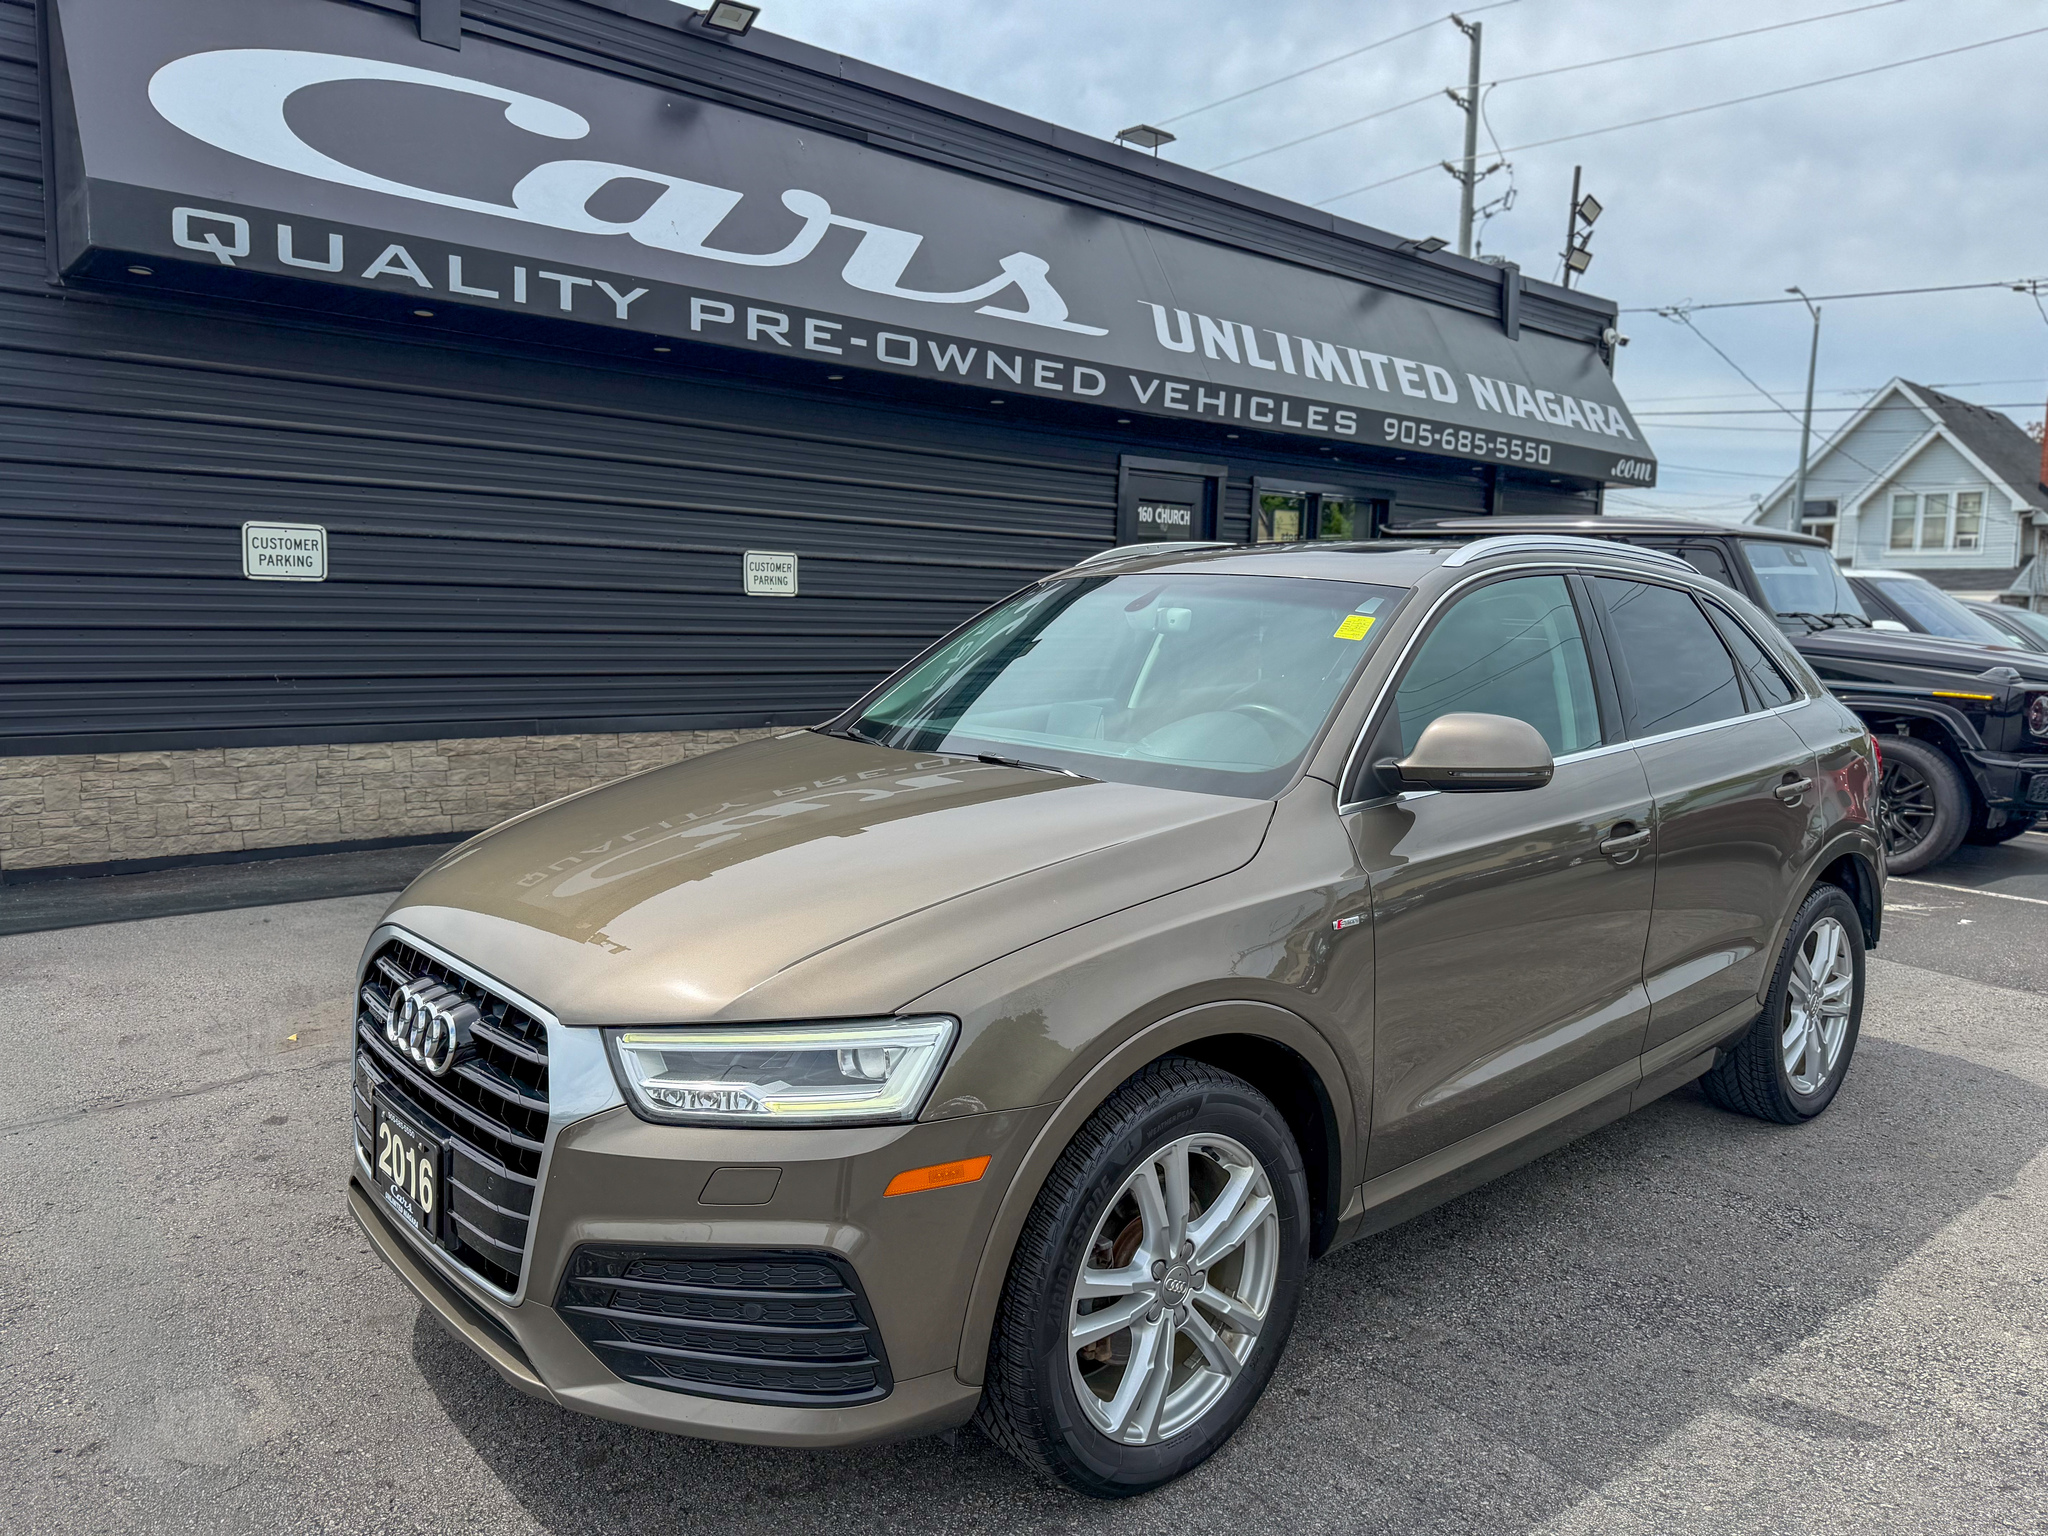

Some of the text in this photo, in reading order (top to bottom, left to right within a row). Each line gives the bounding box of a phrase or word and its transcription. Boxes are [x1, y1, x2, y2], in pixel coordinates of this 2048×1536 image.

[148, 48, 1109, 337] Cars
[172, 206, 1551, 465] QUALITY PRE-OWNED VEHICLES 905-685-5550
[1137, 300, 1638, 441] UNLIMITED NIAGARA
[1611, 459, 1652, 482] .com
[1137, 506, 1190, 525] 160 CHURCH
[252, 536, 319, 551] CUSTOMER
[259, 553, 313, 567] PARKING
[749, 561, 792, 573] CUSTOMER
[753, 575, 788, 586] PARKING
[379, 1122, 433, 1213] 2016
[390, 1184, 414, 1214] Cars
